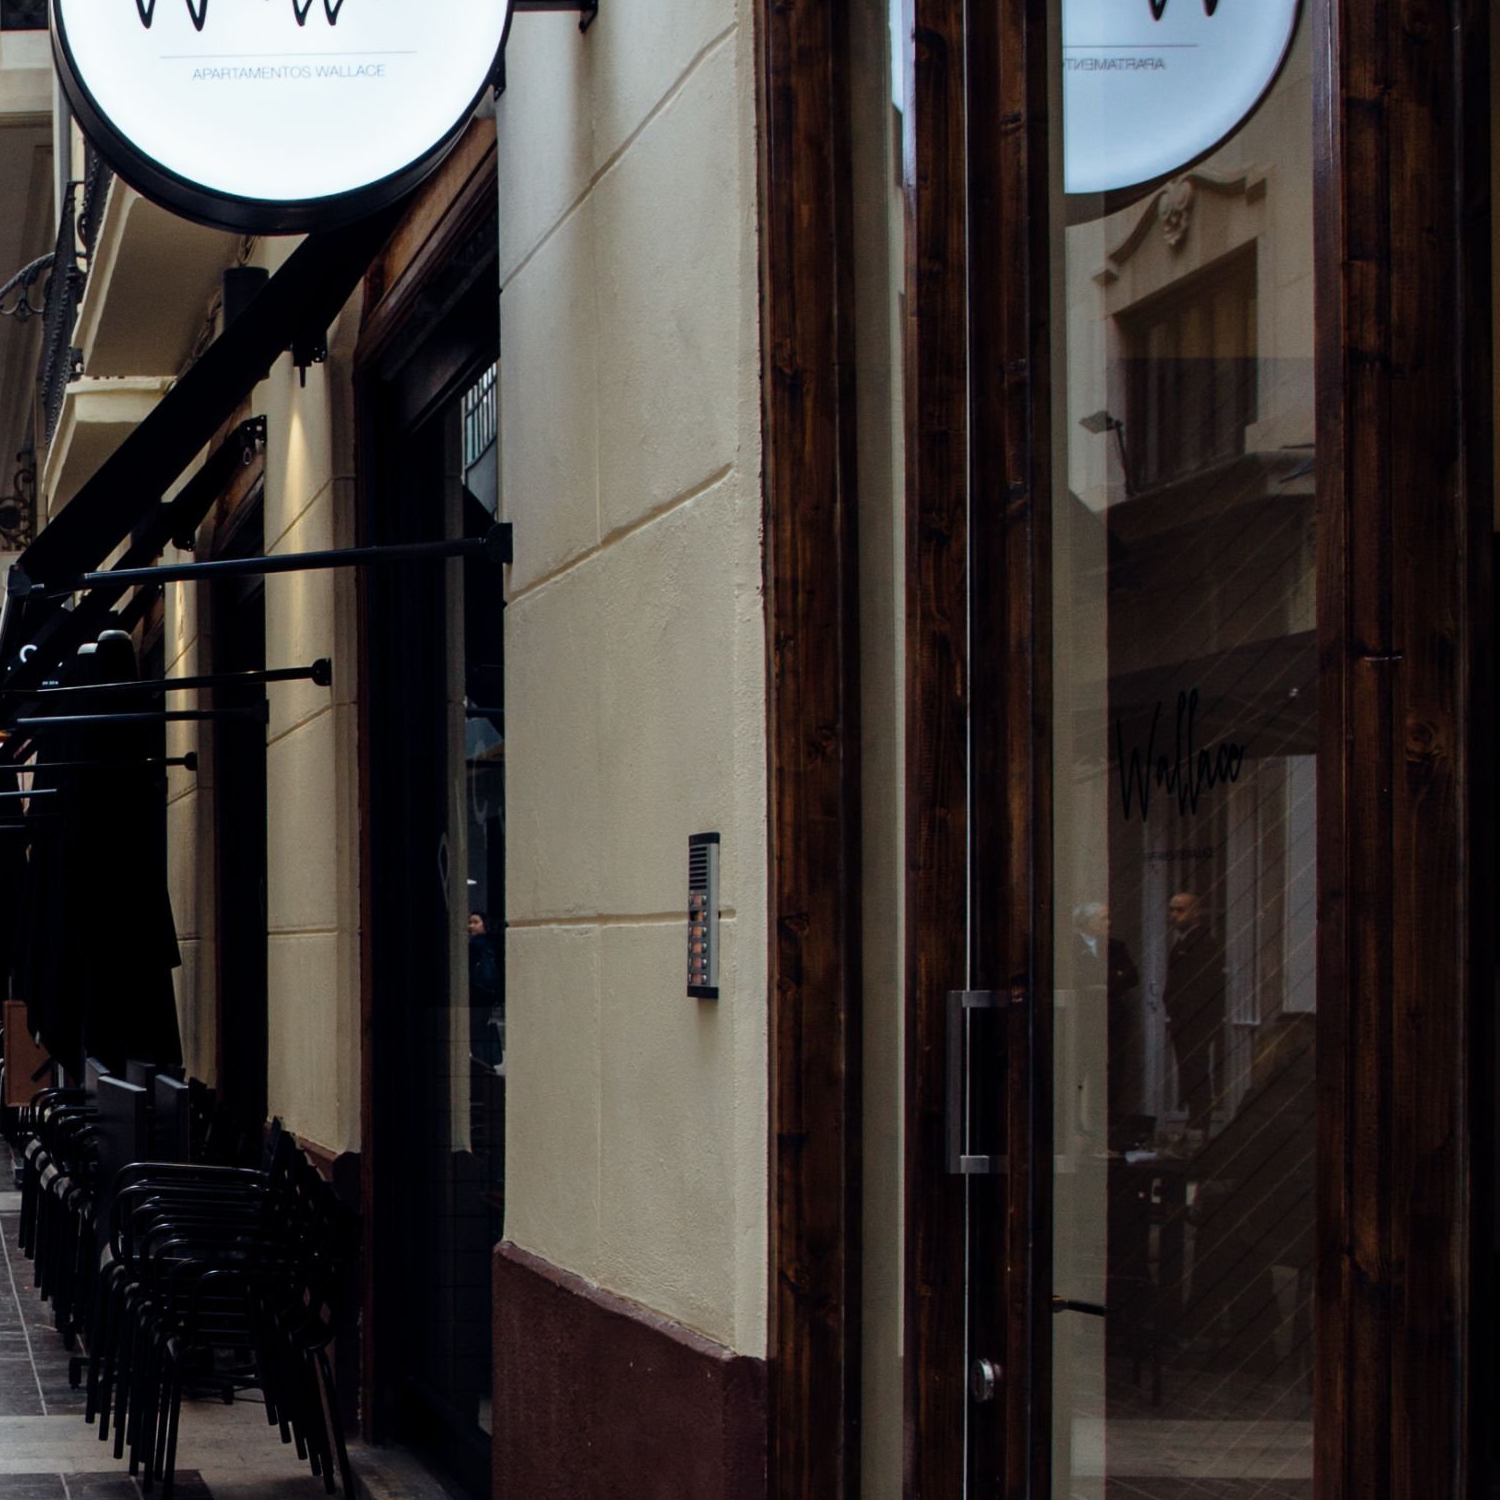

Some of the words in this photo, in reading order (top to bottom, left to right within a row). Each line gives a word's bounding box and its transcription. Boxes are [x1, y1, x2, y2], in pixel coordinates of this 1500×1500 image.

[192, 65, 312, 81] APARTAMENTOS
[315, 63, 387, 78] WALLACE
[1116, 688, 1245, 822] Wallace
